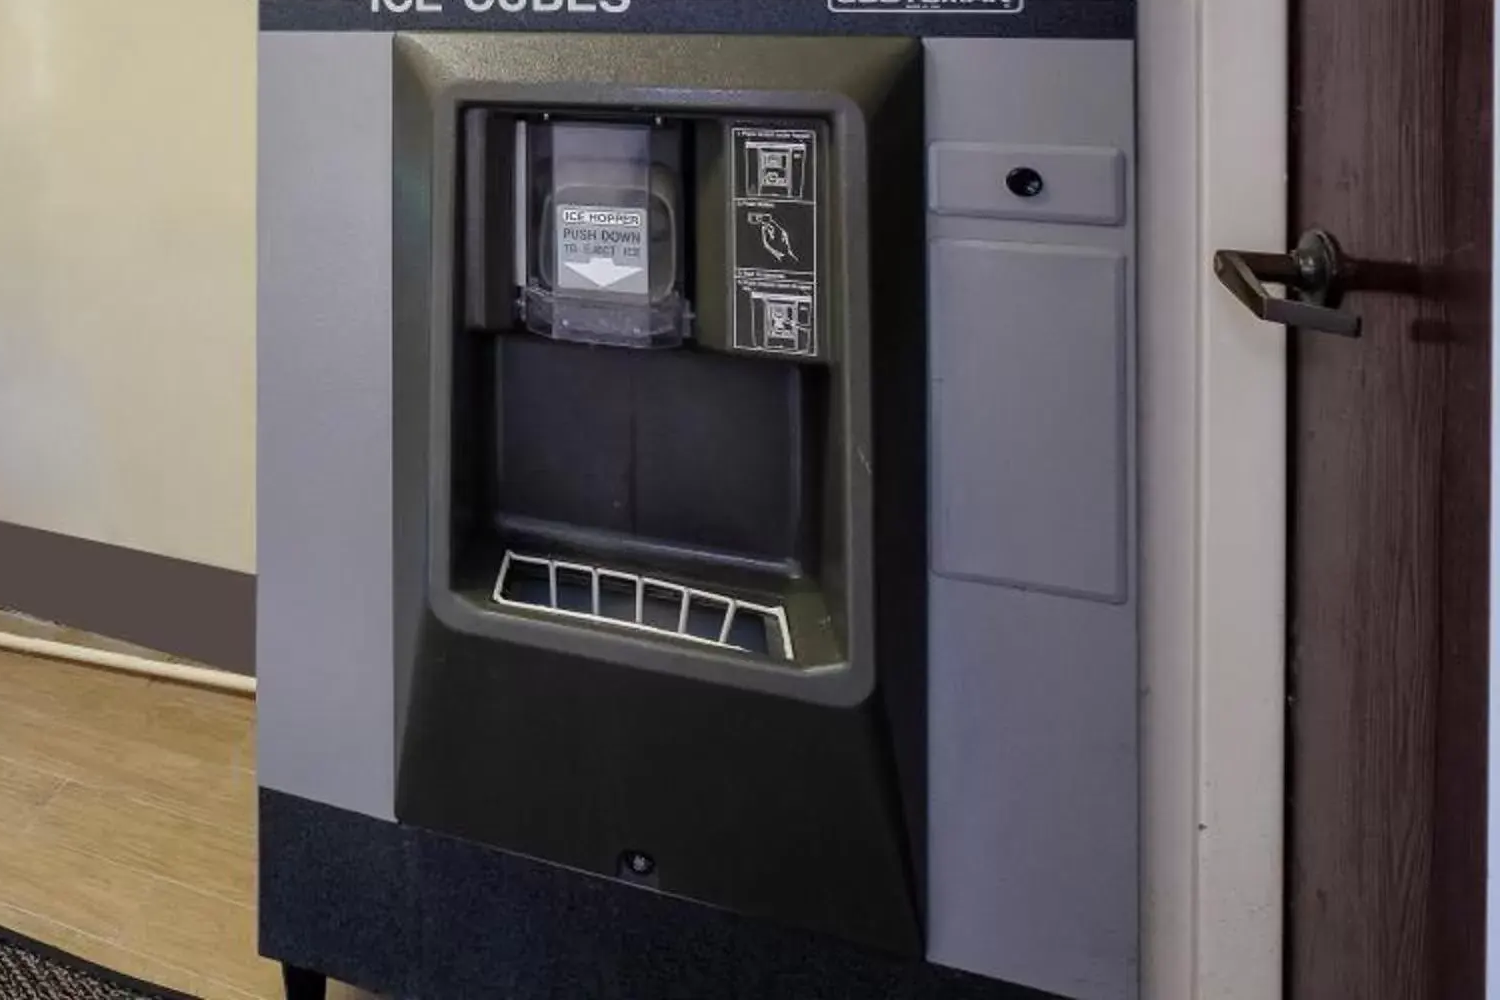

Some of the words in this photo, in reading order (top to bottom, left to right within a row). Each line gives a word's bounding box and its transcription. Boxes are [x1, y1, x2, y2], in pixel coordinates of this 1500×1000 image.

[564, 211, 584, 221] ICE
[563, 228, 596, 241] PUSH
[601, 230, 641, 245] DOWN
